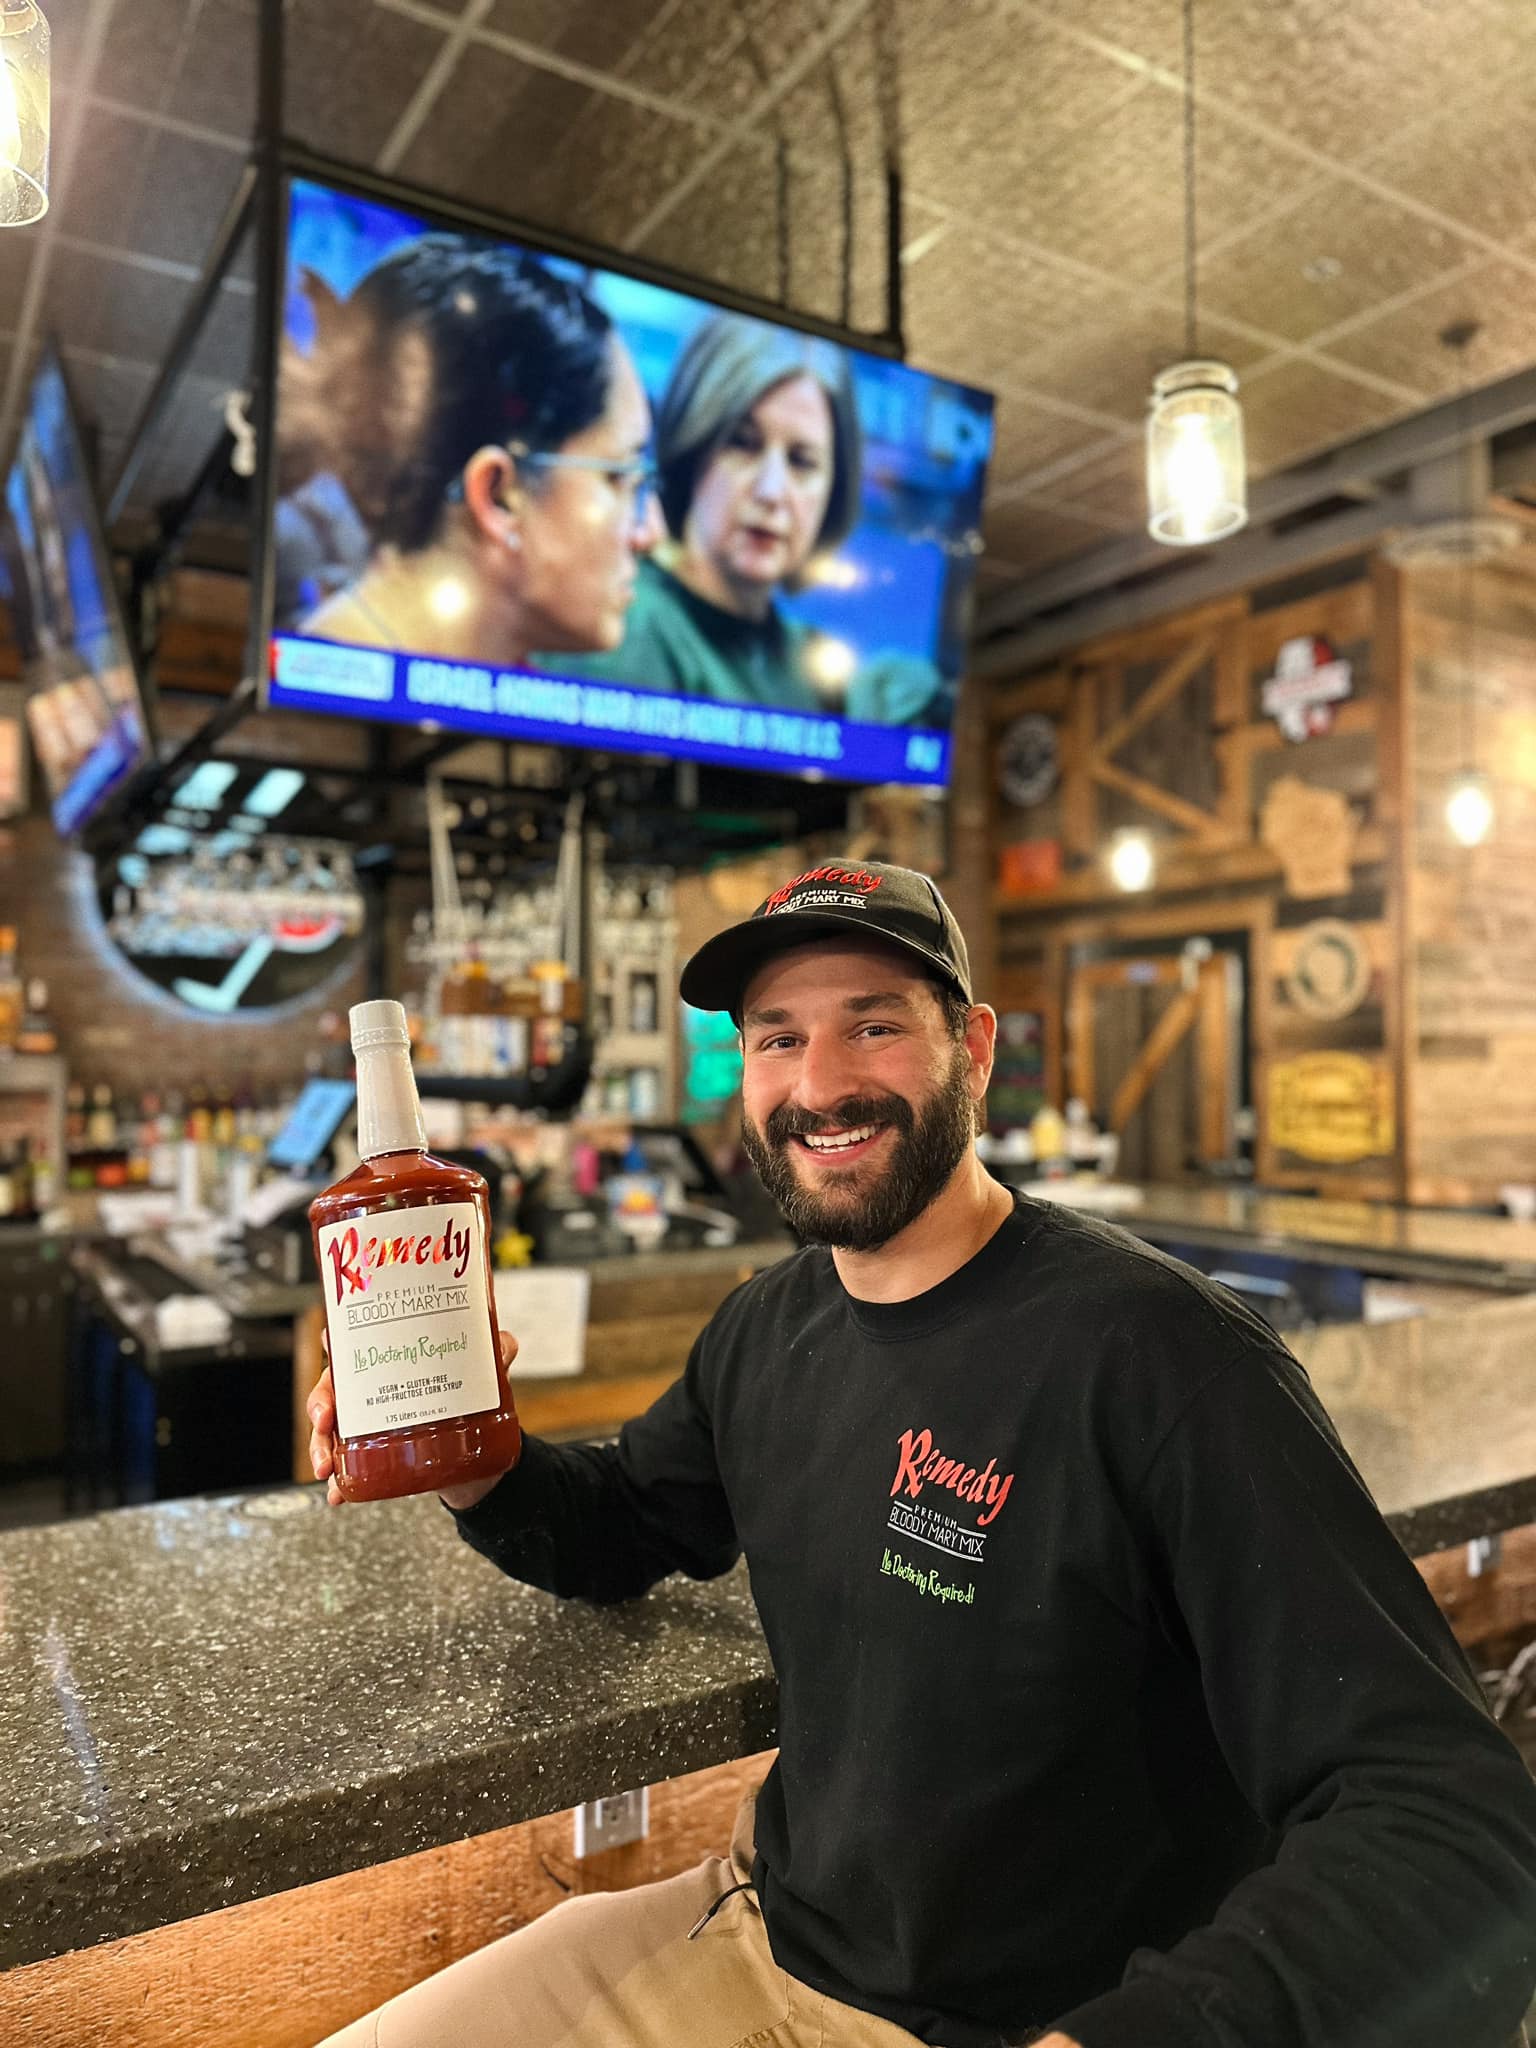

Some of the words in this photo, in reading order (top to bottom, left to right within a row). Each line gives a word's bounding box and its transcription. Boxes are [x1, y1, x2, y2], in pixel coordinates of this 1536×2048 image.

[804, 895, 840, 905] MARY
[843, 896, 865, 906] MIX
[328, 1218, 470, 1306] Remedy
[348, 1302, 396, 1325] BLOODY
[401, 1294, 441, 1314] MARY
[446, 1290, 468, 1307] MIX
[377, 1284, 435, 1301] PREMIUM
[354, 1349, 368, 1370] No
[368, 1345, 417, 1366] Doctoring
[418, 1332, 467, 1360] Required!
[375, 1388, 422, 1404] HIGH-FRUCTOSE
[425, 1386, 441, 1395] CORN
[443, 1380, 463, 1392] SYRUP
[379, 1384, 398, 1394] VEGAN
[406, 1375, 448, 1389] GLUTEN-FREE
[890, 1428, 1015, 1526] Remedy
[889, 1506, 927, 1535] BLOODY
[927, 1523, 958, 1548] MARY
[959, 1535, 984, 1556] MIX
[914, 1504, 957, 1530] PREMIUM
[880, 1547, 893, 1575] No
[892, 1554, 927, 1595] Doctoring
[927, 1569, 975, 1604] Required!
